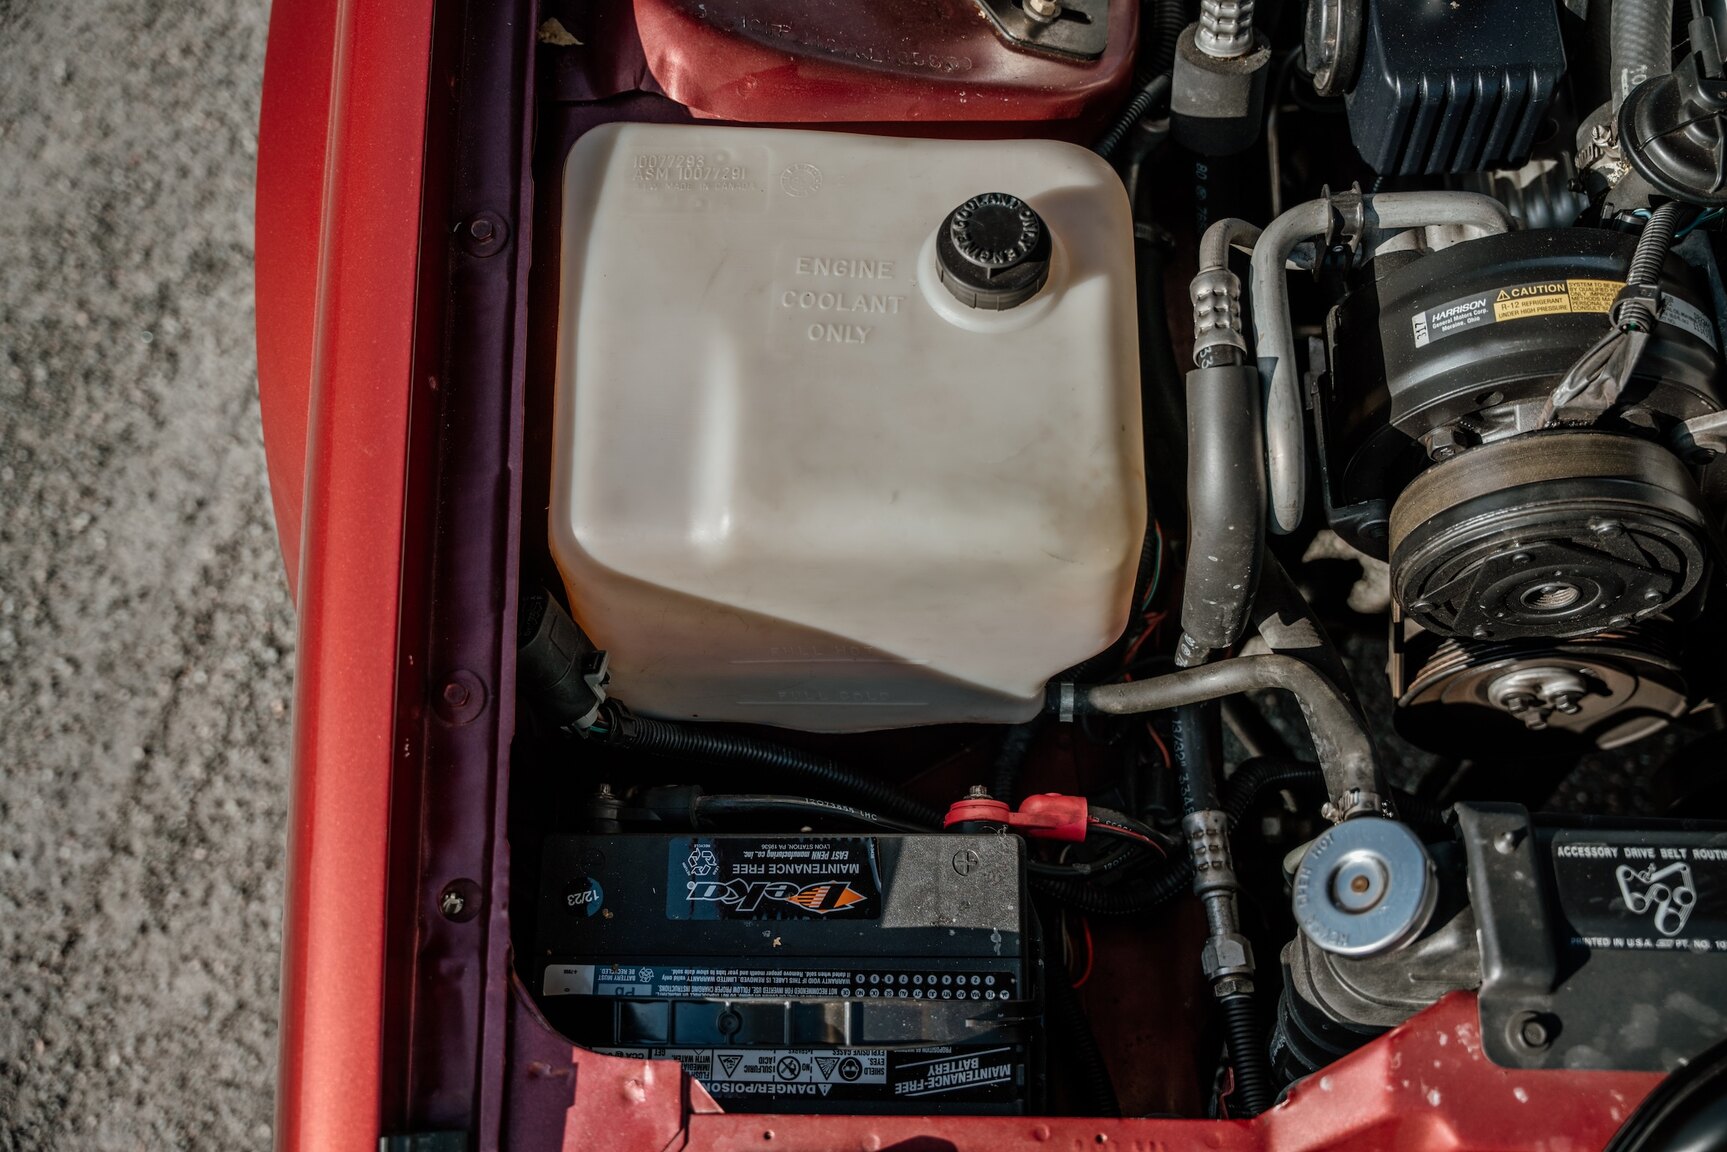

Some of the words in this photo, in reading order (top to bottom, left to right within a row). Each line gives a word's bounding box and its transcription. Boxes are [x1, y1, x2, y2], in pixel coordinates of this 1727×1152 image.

[632, 167, 669, 180] ASM
[795, 257, 896, 279] ENGINE
[1511, 283, 1566, 297] CAUTION
[781, 290, 906, 314] COOLANT
[1501, 300, 1520, 311] R-12
[1521, 297, 1563, 307] REFRIGERANT
[1432, 298, 1487, 322] HARRISON
[1498, 309, 1520, 318] UNDER
[1520, 307, 1536, 315] HIGH
[1537, 304, 1568, 312] PRESSURE
[1432, 317, 1453, 330] General
[1453, 311, 1472, 322] Motors
[1473, 308, 1489, 316] Corp.
[1466, 316, 1481, 324] Ohio
[808, 323, 874, 344] ONLY
[743, 850, 753, 859] inc.
[766, 849, 810, 860] manufacturing
[811, 850, 830, 860] PENN
[831, 850, 848, 860] EAST
[1557, 846, 1619, 858] ACCESSORY
[1623, 847, 1656, 859] DRIVE
[1660, 848, 1687, 859] BELT
[732, 863, 764, 874] FREE
[769, 863, 860, 874] MAINTENANCE
[567, 889, 600, 906] 12/23
[686, 878, 866, 914] Deka
[1571, 937, 1611, 948] PRINTED
[1613, 938, 1624, 948] IN
[1626, 938, 1652, 948] U.S.A.
[1675, 938, 1690, 949] PT.
[1693, 939, 1710, 950] NO.
[693, 1055, 711, 1063] WITH
[758, 1056, 773, 1065] ACID
[867, 1058, 885, 1066] EYES.
[743, 1065, 773, 1073] SULFURIC
[801, 1063, 811, 1071] NO
[864, 1067, 885, 1075] SHIELD
[927, 1057, 979, 1076] BATTERY
[894, 1063, 1011, 1094] MAINTENANCE-FREE
